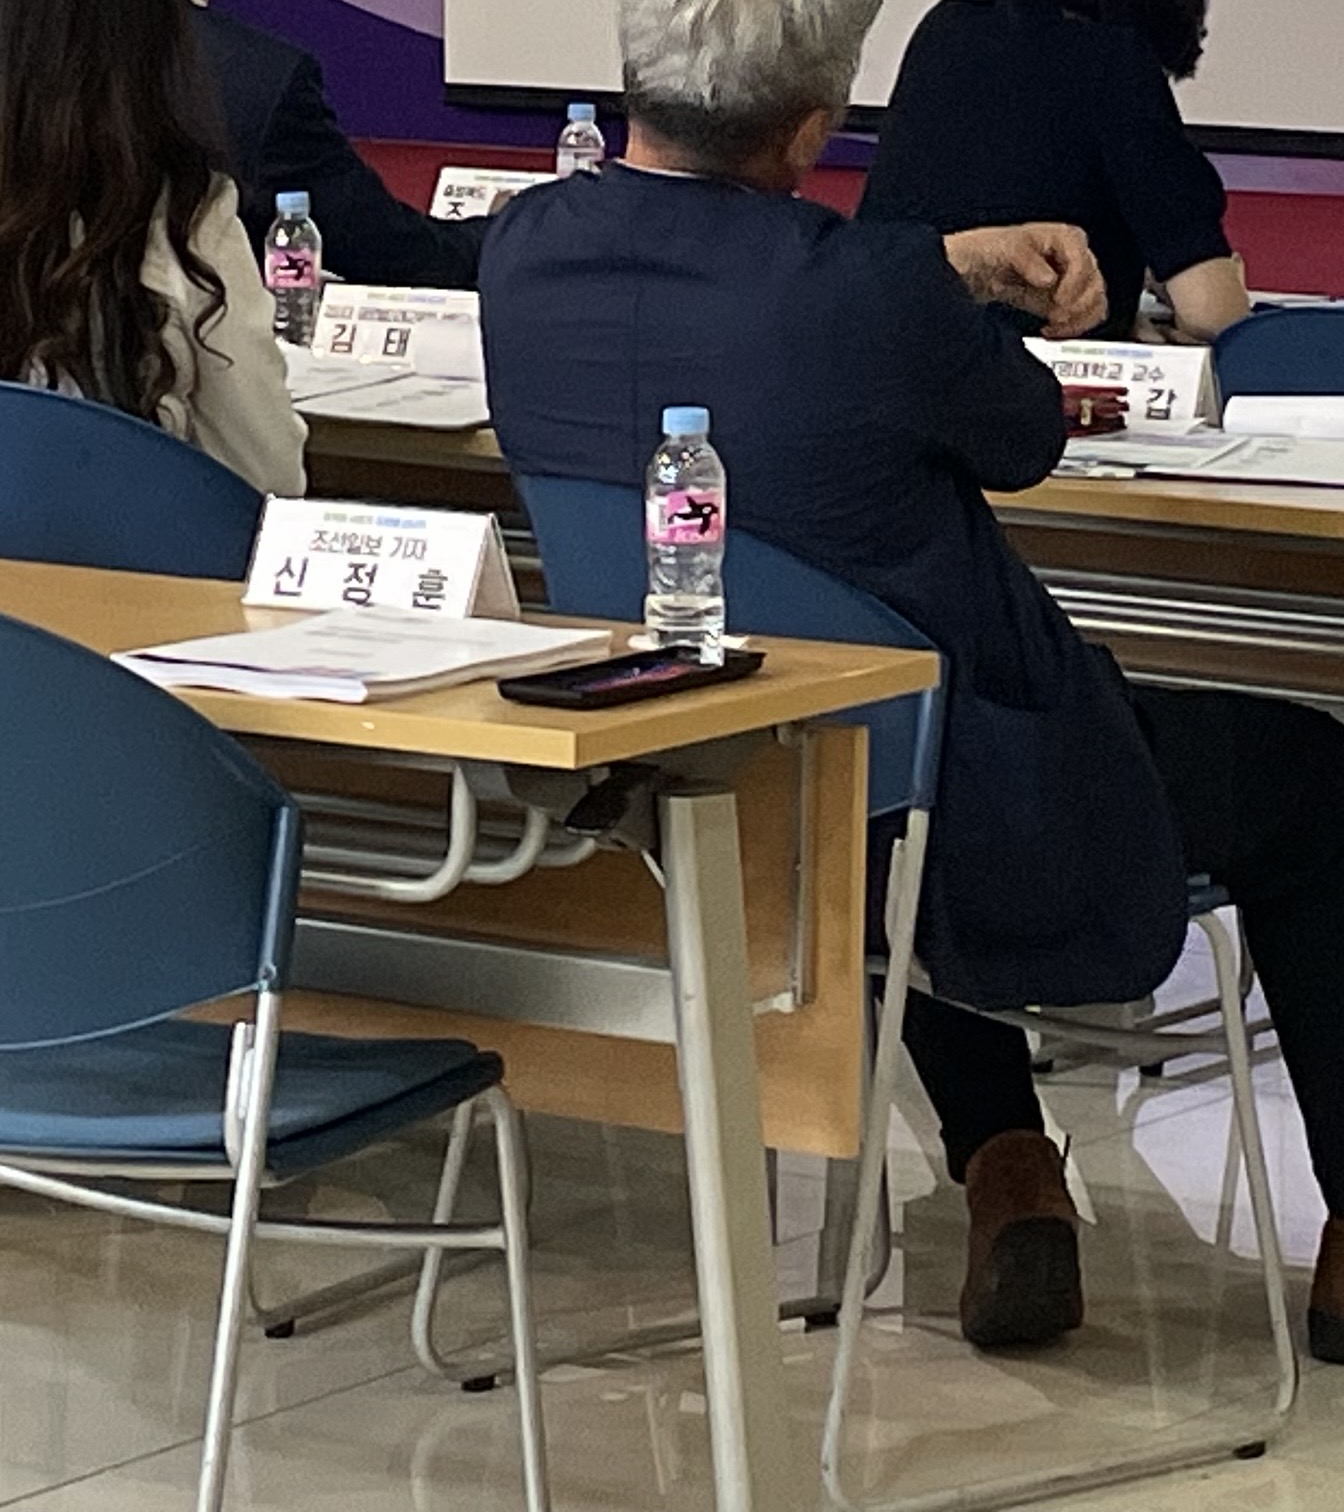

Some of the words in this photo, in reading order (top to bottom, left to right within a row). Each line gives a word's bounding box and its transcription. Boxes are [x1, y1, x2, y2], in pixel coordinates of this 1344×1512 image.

[329, 322, 358, 355] 김
[1130, 362, 1166, 384] 교수
[1144, 387, 1179, 421] 갑
[308, 528, 385, 559] 조선일보
[388, 536, 429, 562] 기자
[272, 555, 309, 598] 신
[341, 560, 380, 606] 정
[410, 567, 449, 611] 훈
